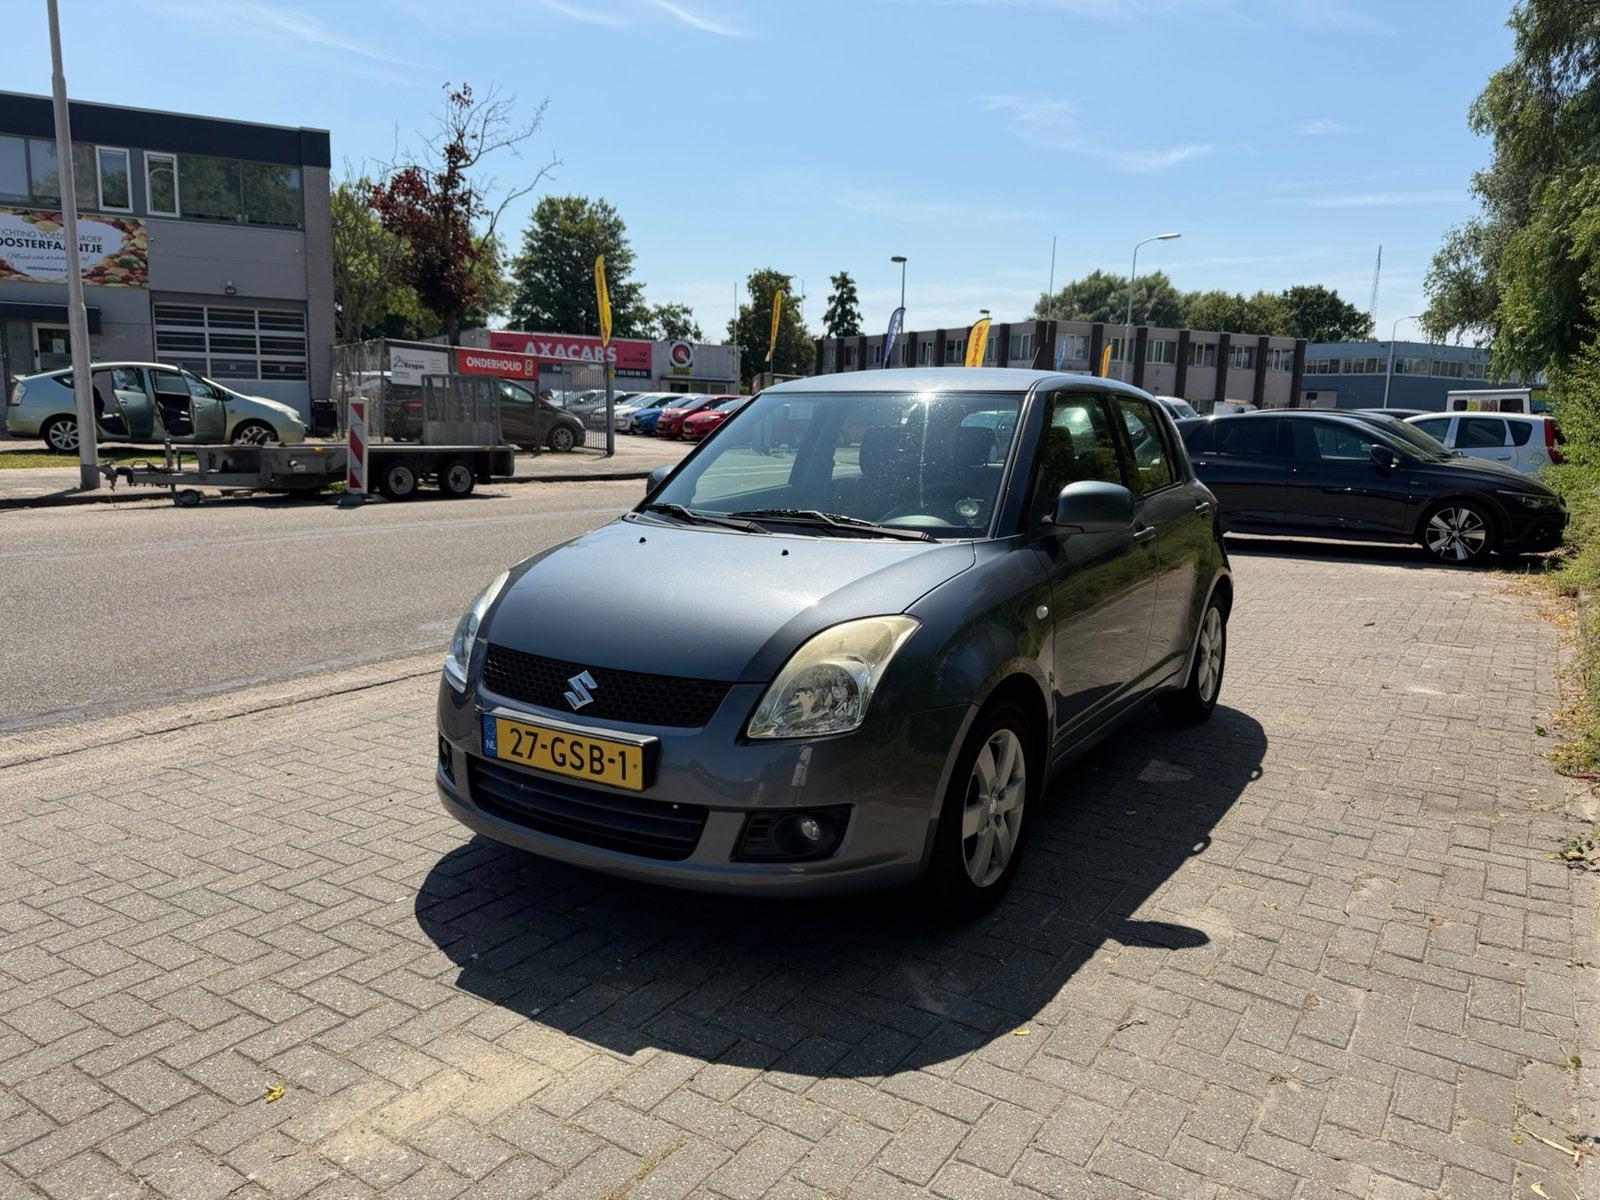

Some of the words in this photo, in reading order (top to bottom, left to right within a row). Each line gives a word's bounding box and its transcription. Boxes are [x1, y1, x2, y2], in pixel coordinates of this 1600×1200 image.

[0, 228, 36, 238] ICHTING
[0, 237, 103, 253] OSTERFATJE
[524, 341, 618, 362] AXACARS
[466, 356, 523, 372] ONDERHOUD
[485, 739, 497, 750] NL
[510, 727, 627, 781] 27-GSB-1
